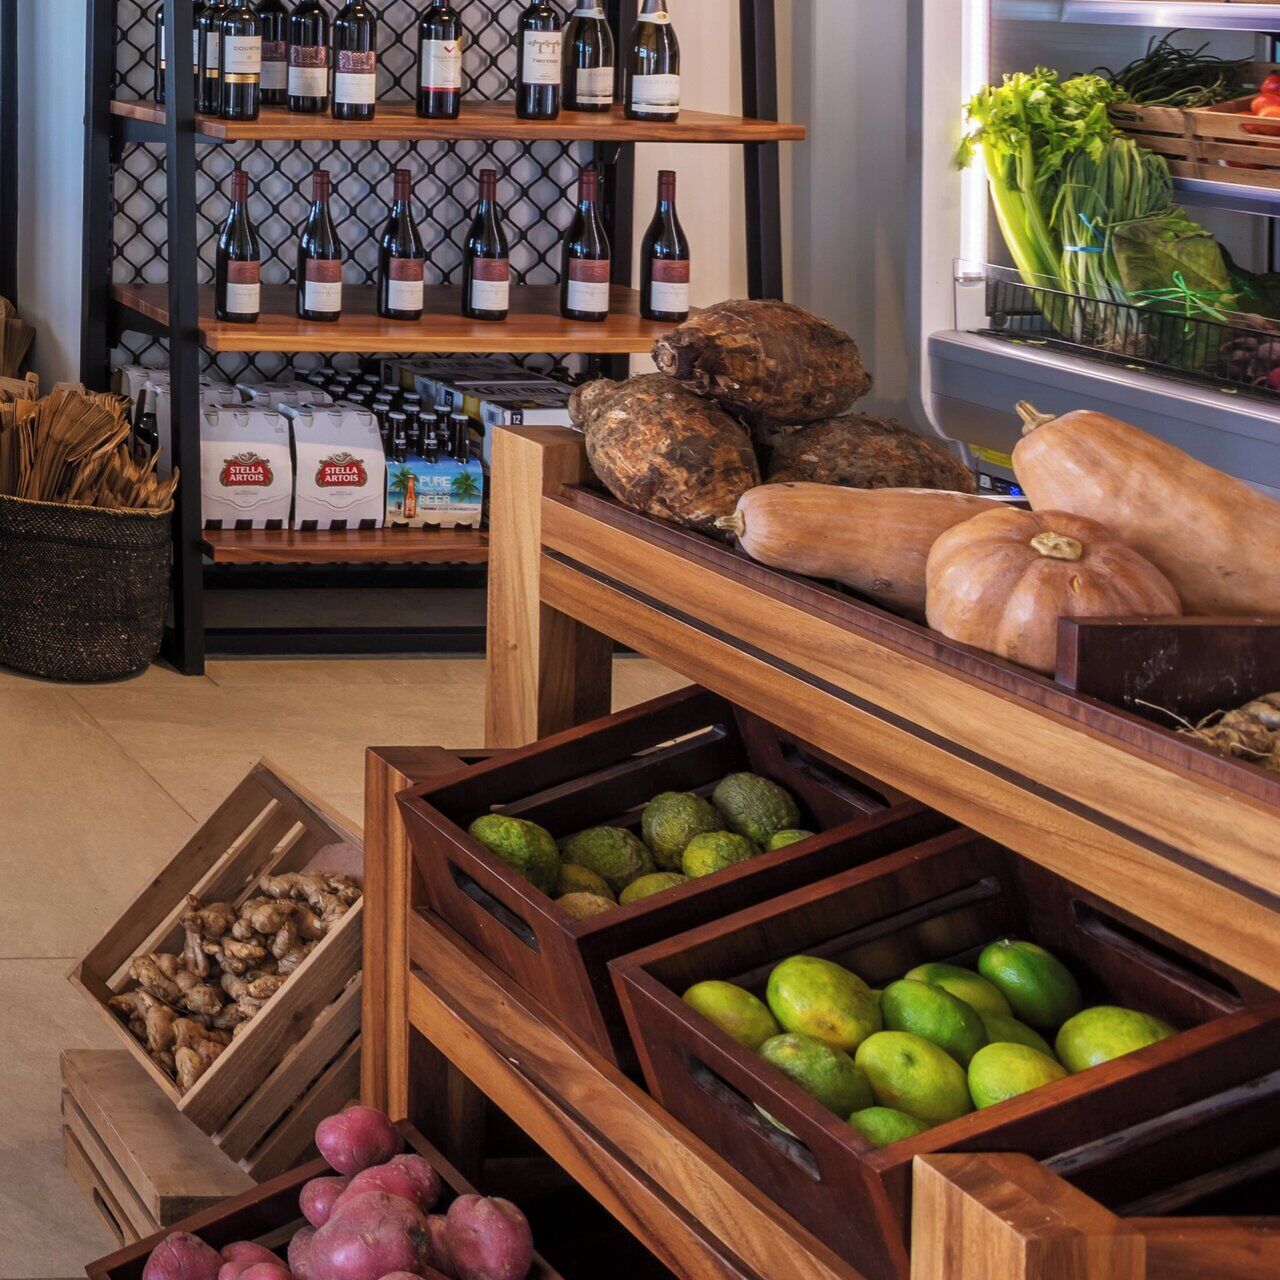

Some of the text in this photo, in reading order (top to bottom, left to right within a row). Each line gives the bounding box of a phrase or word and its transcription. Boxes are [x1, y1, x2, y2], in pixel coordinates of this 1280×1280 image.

[512, 414, 521, 424] 12
[230, 466, 263, 474] STELLA
[325, 466, 358, 474] STELLA
[229, 474, 264, 482] ARTOIS
[325, 474, 359, 482] ARTOIS
[419, 475, 452, 487] PURE
[419, 495, 451, 505] BEER
